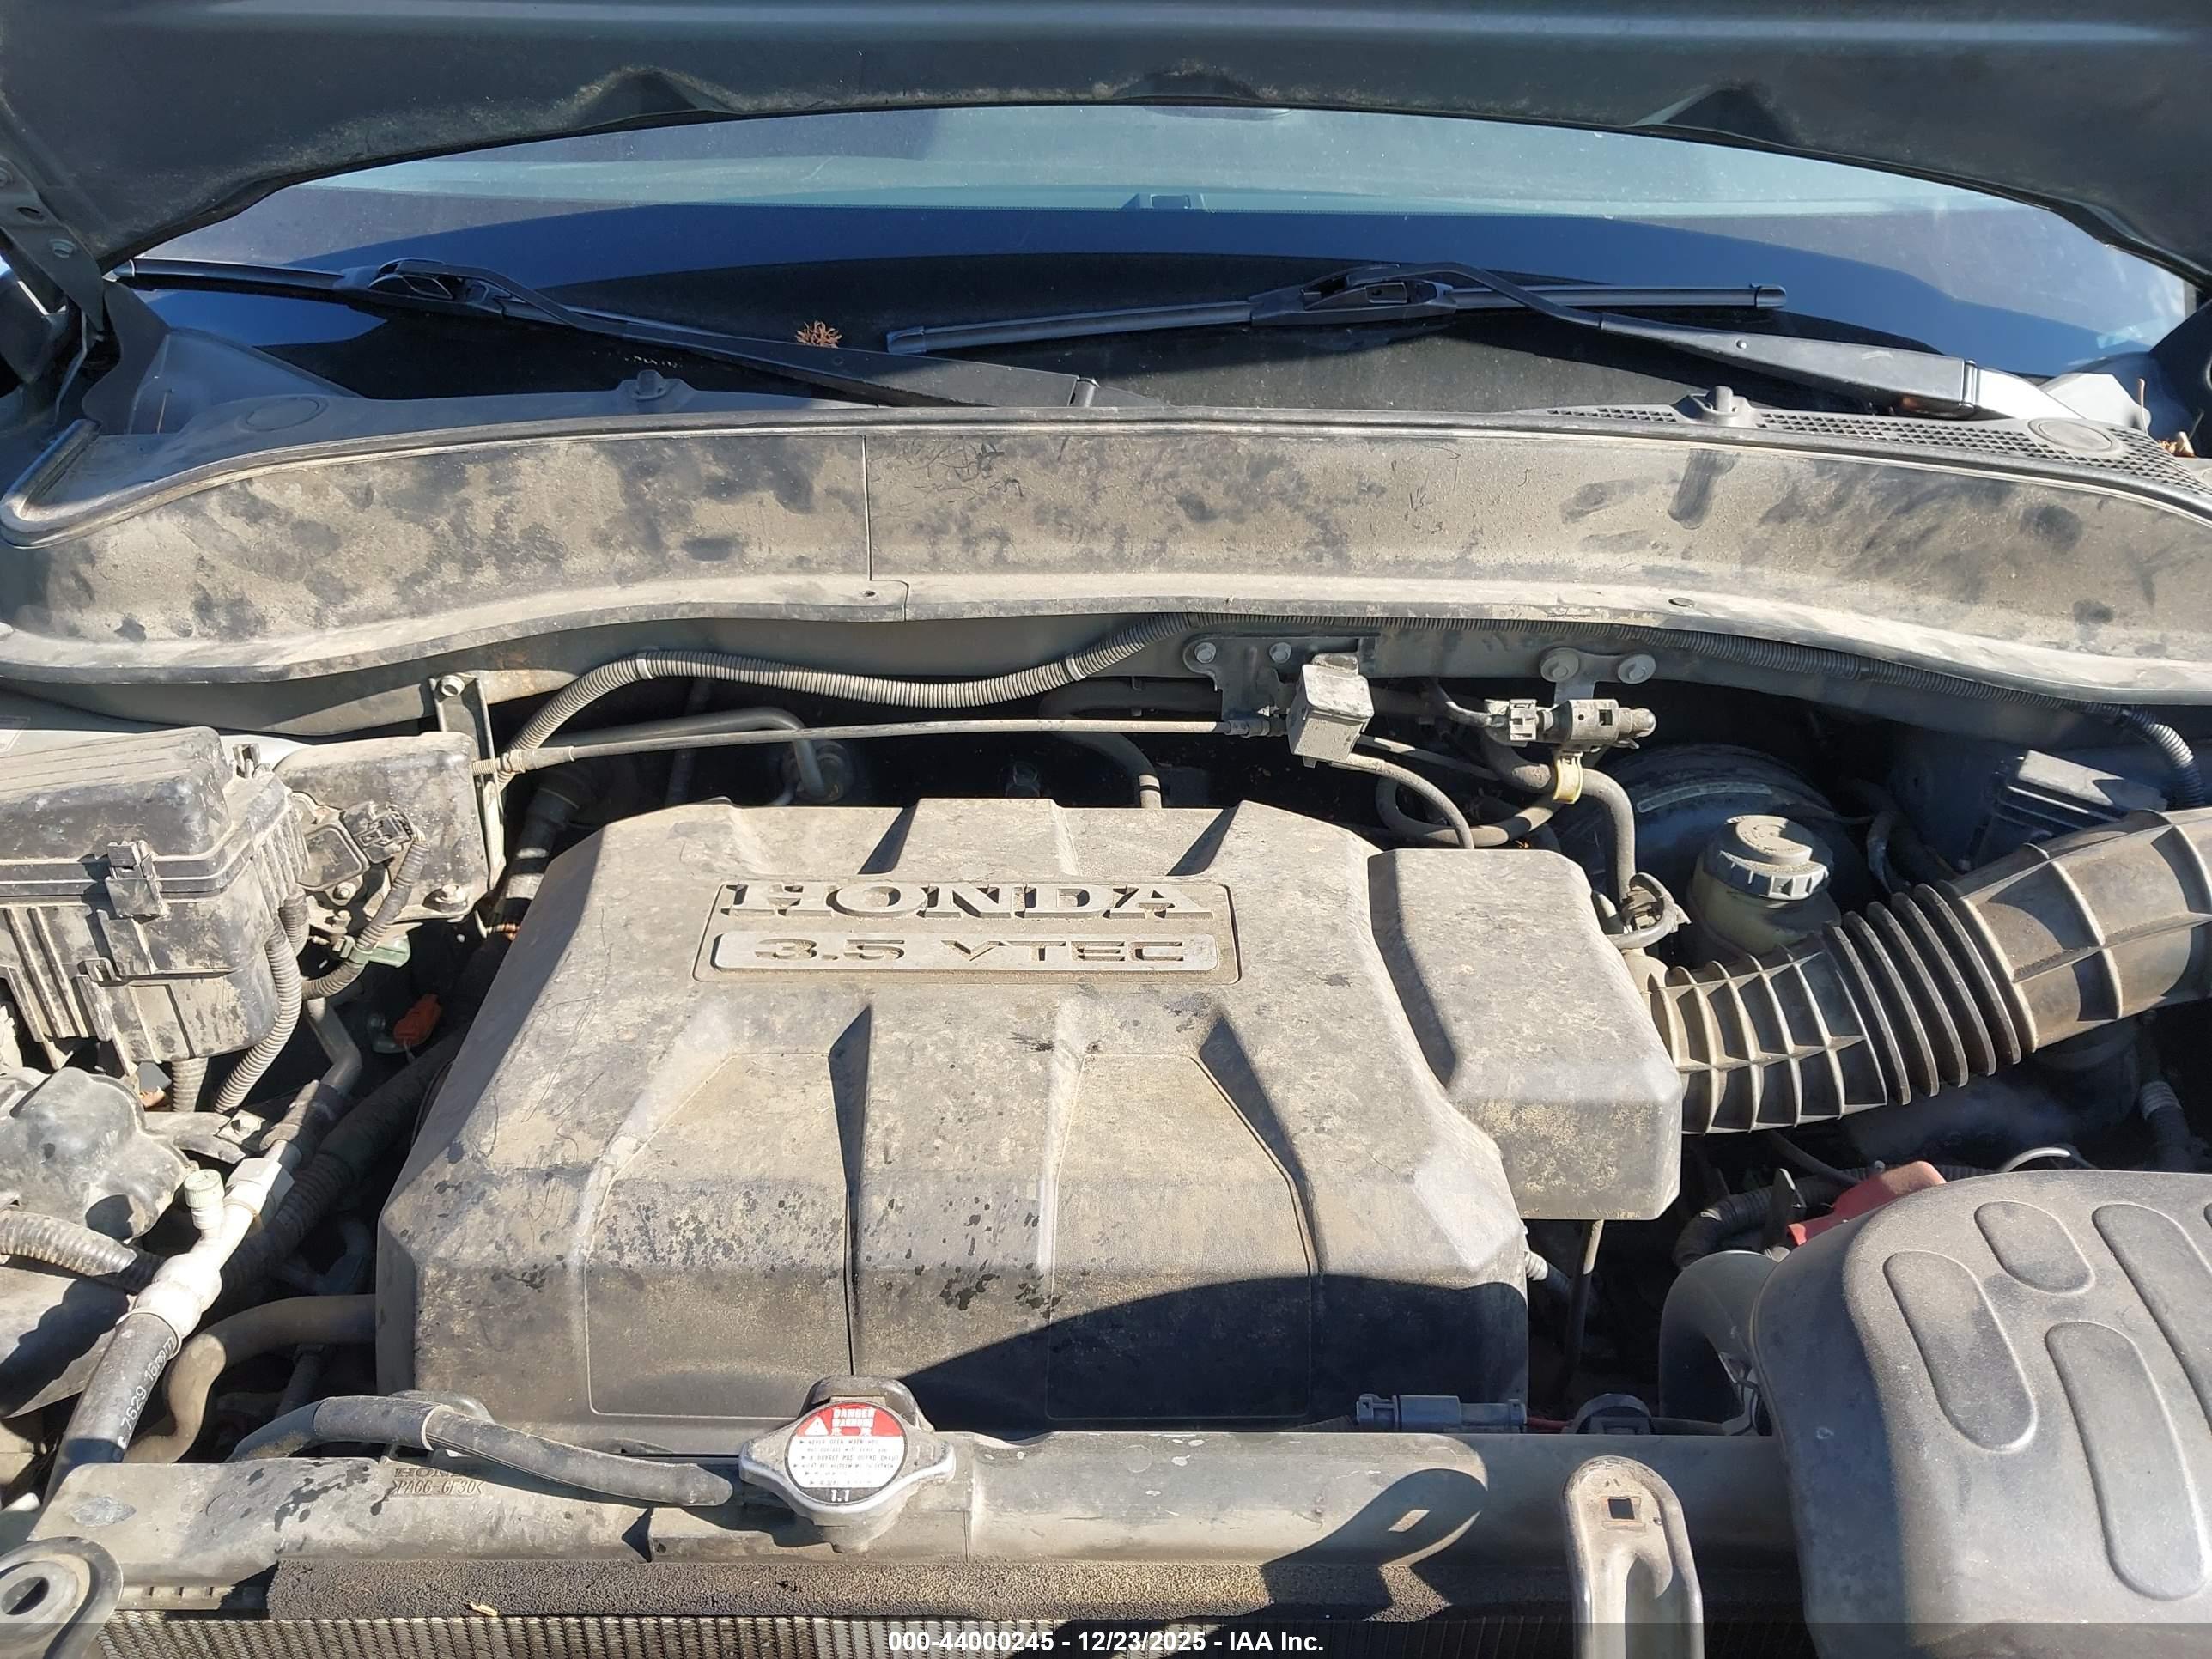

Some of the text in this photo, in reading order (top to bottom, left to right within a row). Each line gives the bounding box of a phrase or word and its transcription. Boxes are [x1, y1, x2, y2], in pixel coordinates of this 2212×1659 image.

[720, 883, 1213, 918] HONDA
[754, 937, 1185, 962] 3.5 VTEC
[833, 1407, 875, 1419] DANGER
[830, 1489, 850, 1503] 1.1
